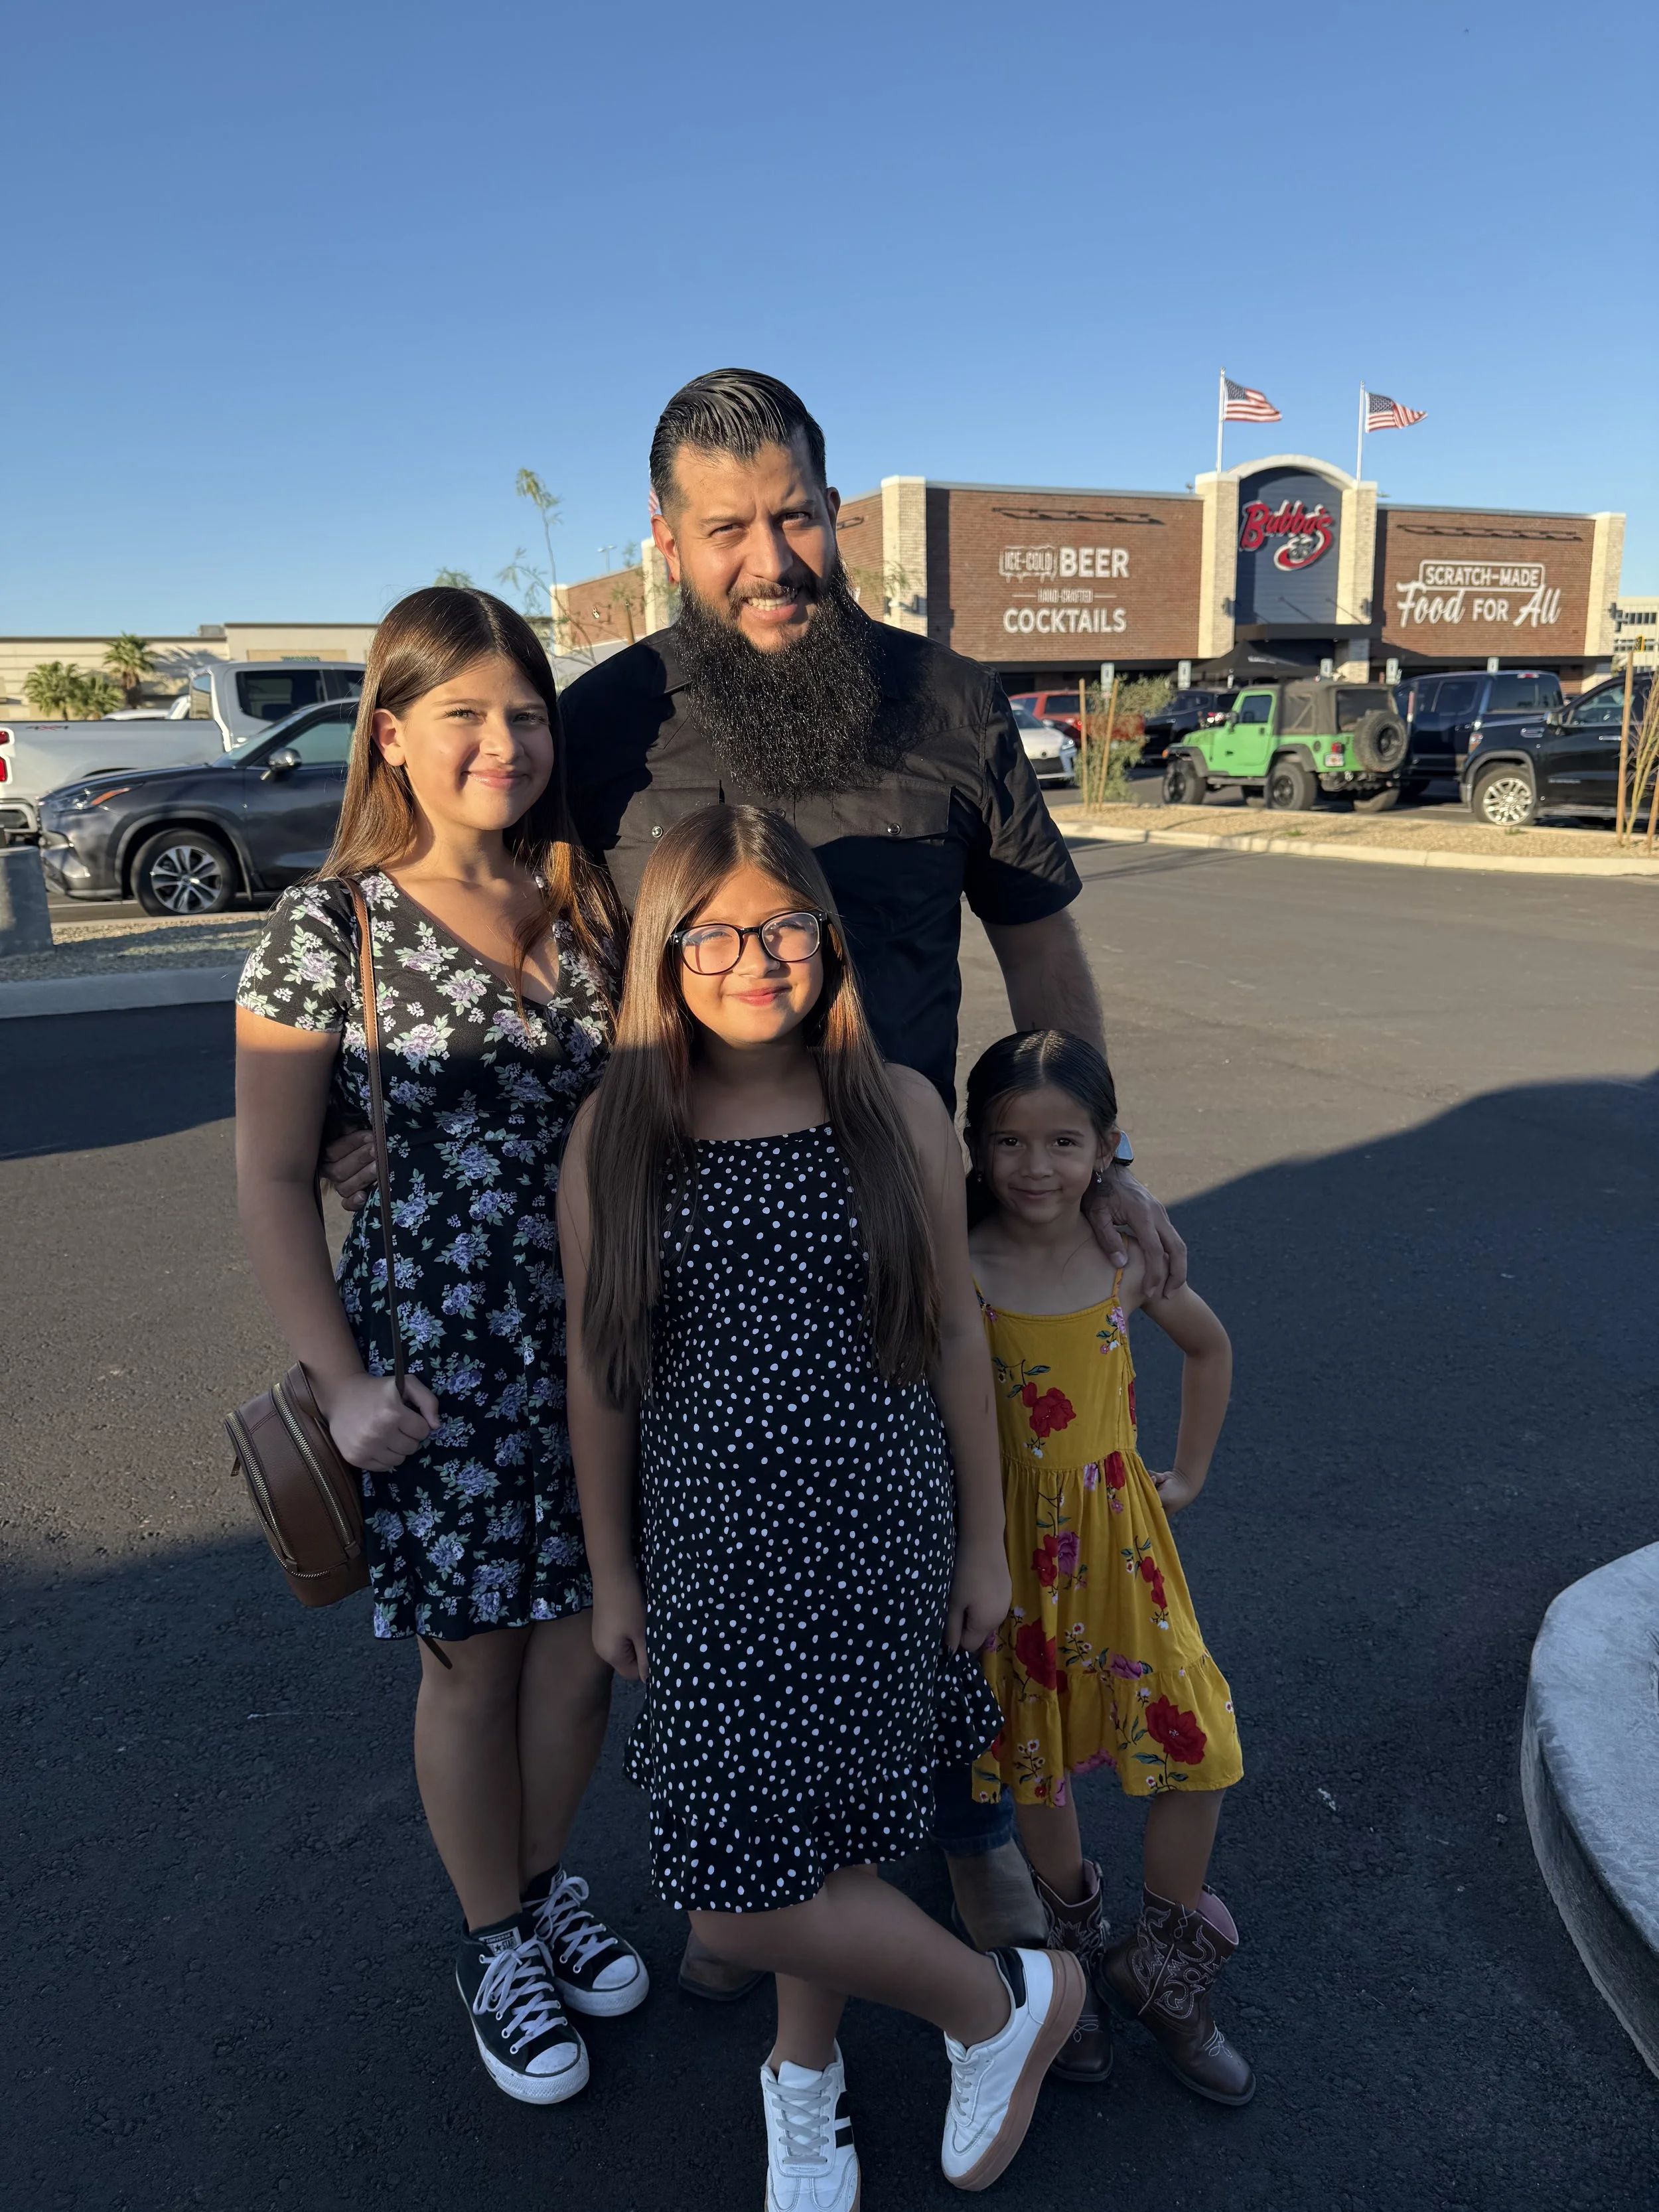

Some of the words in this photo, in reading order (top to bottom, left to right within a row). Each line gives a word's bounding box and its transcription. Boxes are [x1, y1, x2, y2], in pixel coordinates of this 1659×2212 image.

[1240, 500, 1333, 569] Bubba's
[1060, 547, 1129, 577] BEER
[1426, 565, 1540, 587] SCRATCH-MADE
[1396, 580, 1465, 628] Food
[1472, 598, 1509, 621] FOR
[1513, 583, 1561, 627] All
[1003, 607, 1127, 633] COCKTAILS
